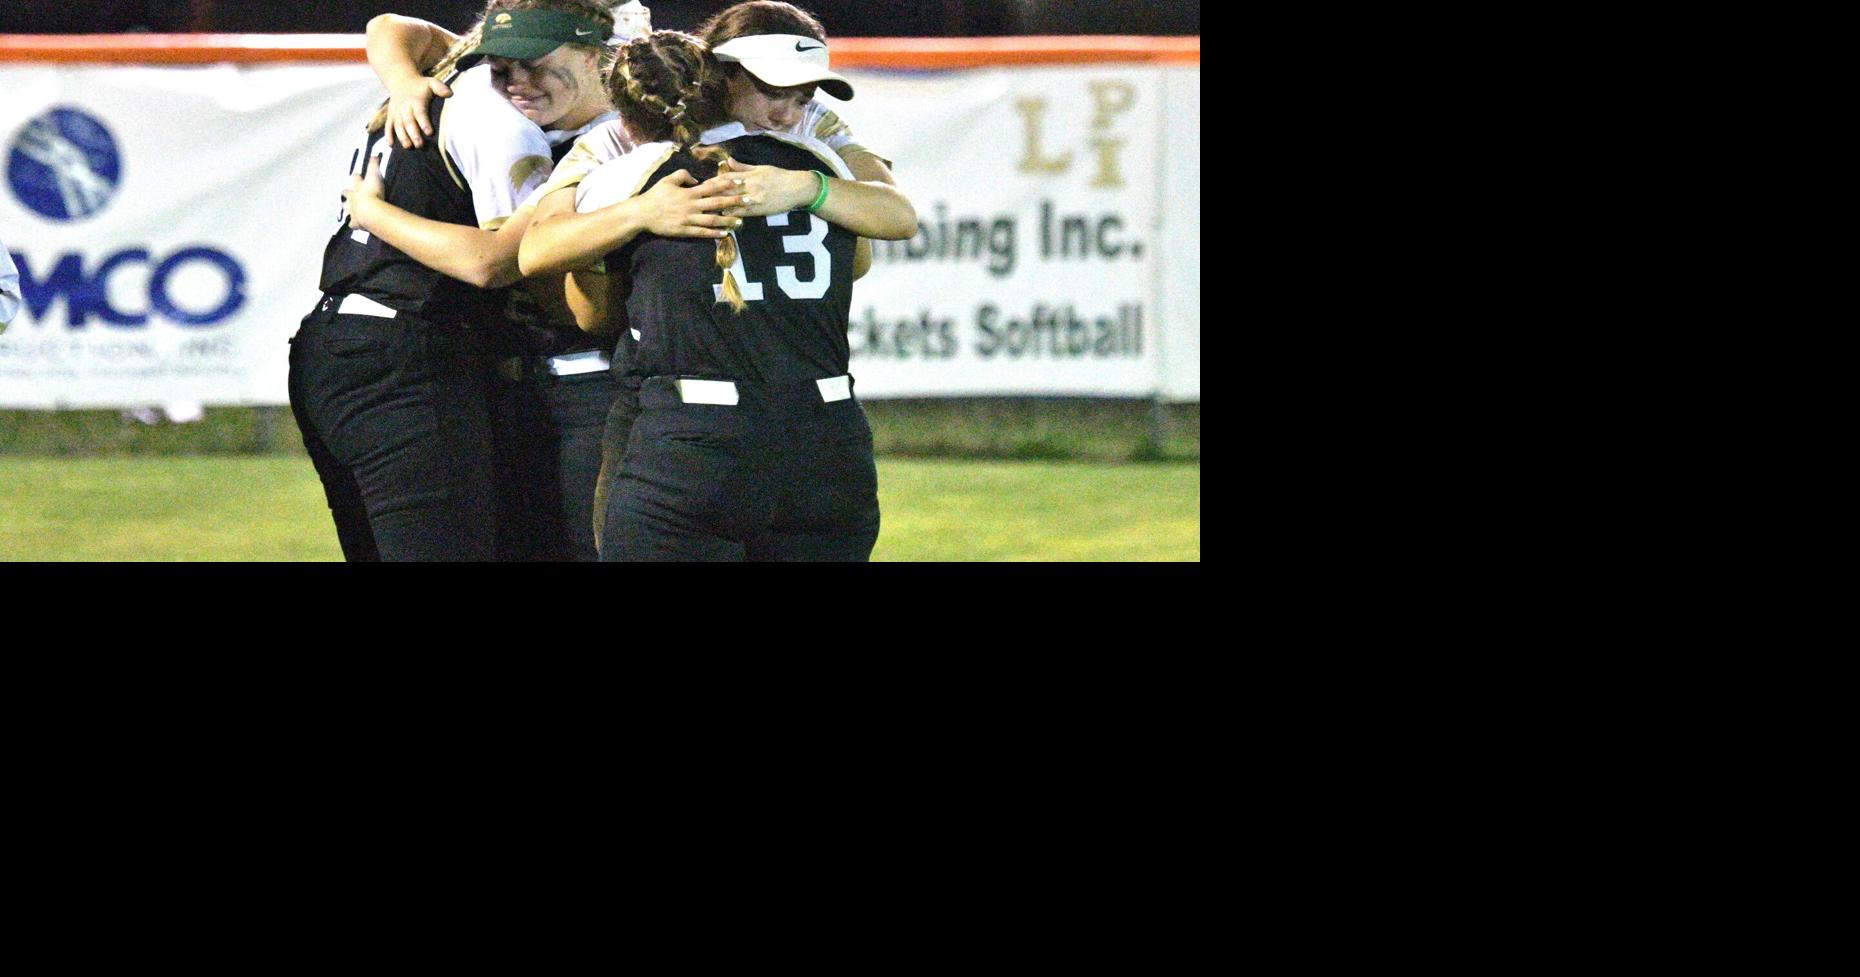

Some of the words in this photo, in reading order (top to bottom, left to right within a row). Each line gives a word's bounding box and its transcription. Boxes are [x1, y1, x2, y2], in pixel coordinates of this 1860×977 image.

[712, 208, 831, 301] 13
[1041, 199, 1143, 262] Inc.
[974, 303, 1144, 359] Softball
